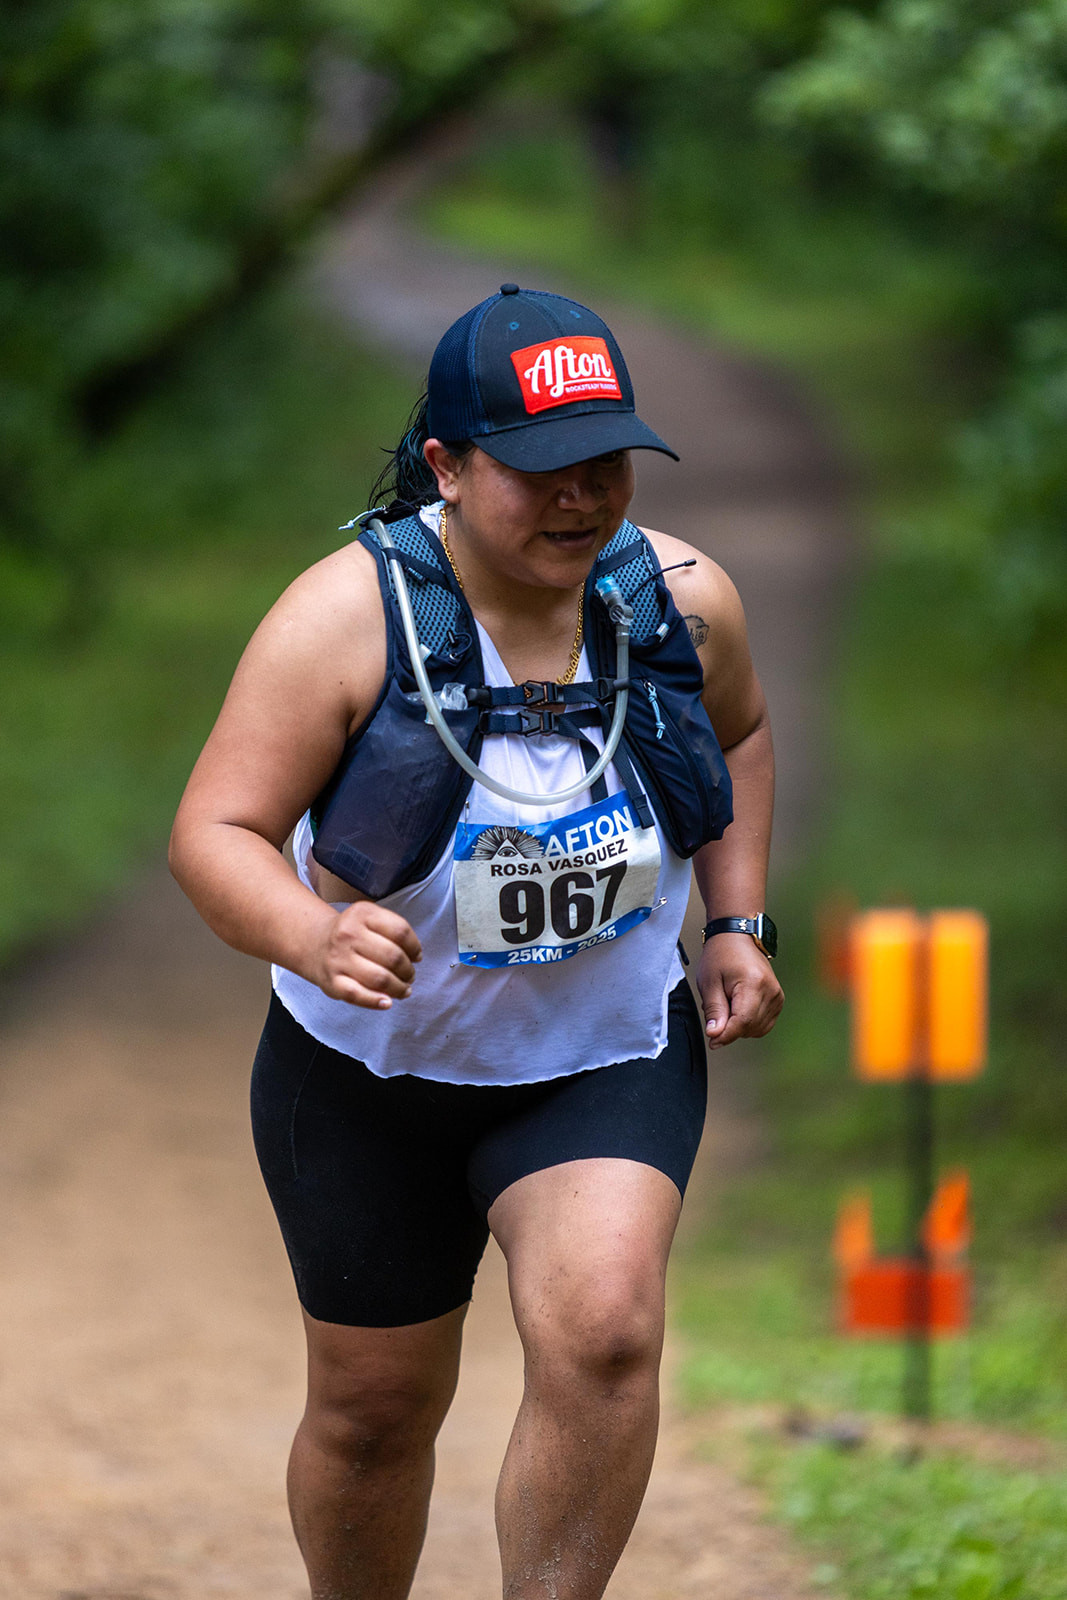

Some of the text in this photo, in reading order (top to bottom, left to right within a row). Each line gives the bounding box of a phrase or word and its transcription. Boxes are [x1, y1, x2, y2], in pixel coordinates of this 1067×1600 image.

[524, 345, 611, 398] Afton
[543, 805, 634, 857] AFTON
[490, 839, 628, 877] ROSA VASQUEZ
[499, 860, 628, 944] 967
[507, 948, 562, 964] 25KM
[577, 925, 617, 951] 2025
